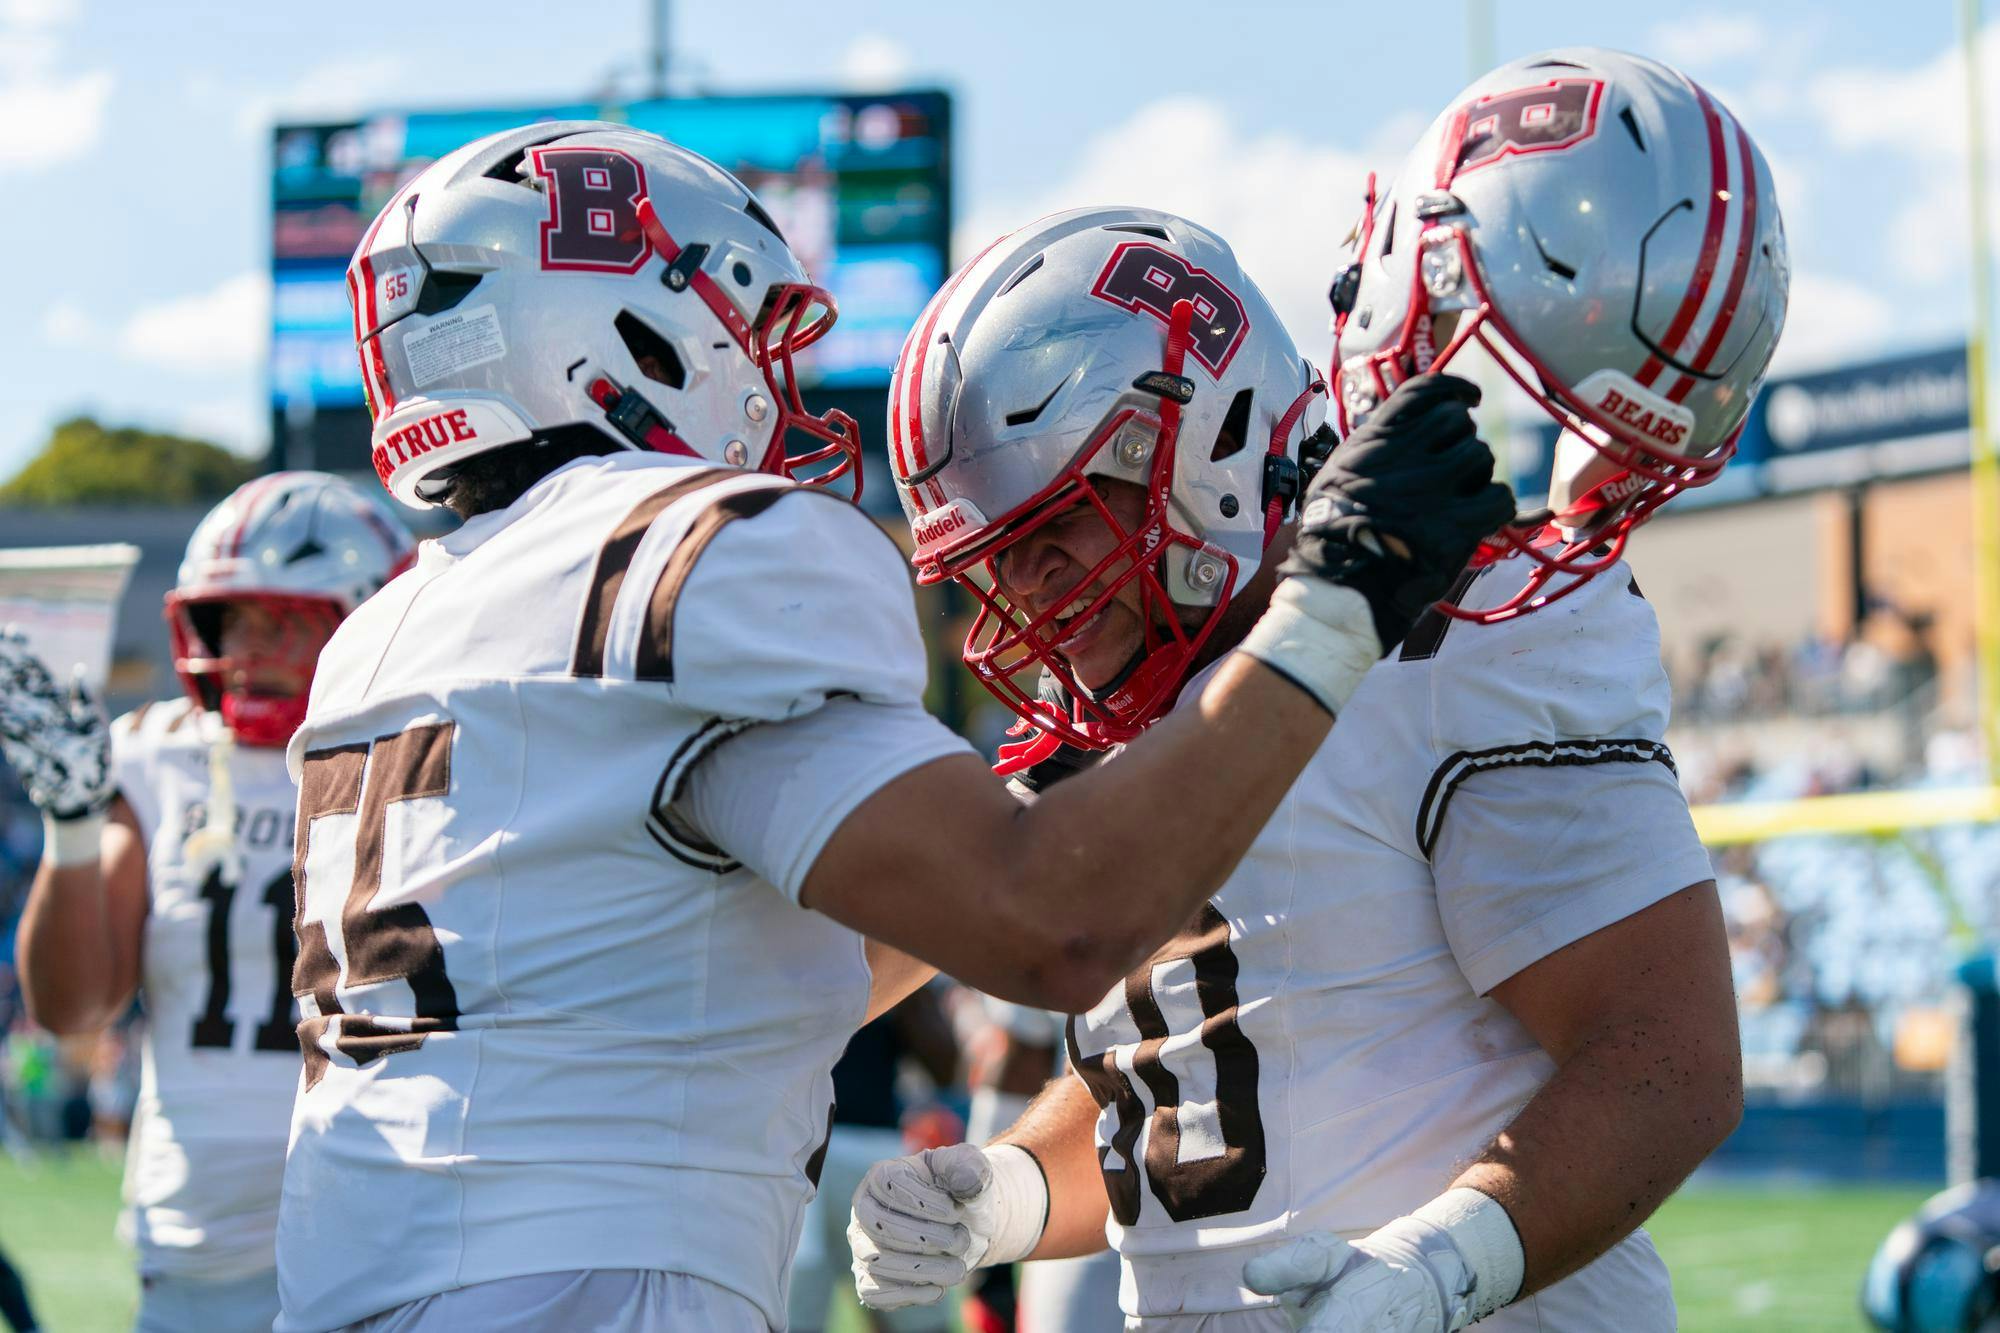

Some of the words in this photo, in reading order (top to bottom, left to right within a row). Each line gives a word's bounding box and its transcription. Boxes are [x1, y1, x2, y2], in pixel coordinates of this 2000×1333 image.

[530, 146, 653, 275] B
[385, 271, 408, 301] 55
[1090, 241, 1251, 381] B
[429, 315, 464, 333] WARNING
[386, 408, 477, 465] TRUE
[1597, 386, 1688, 445] BEARS
[190, 856, 298, 1052] 11
